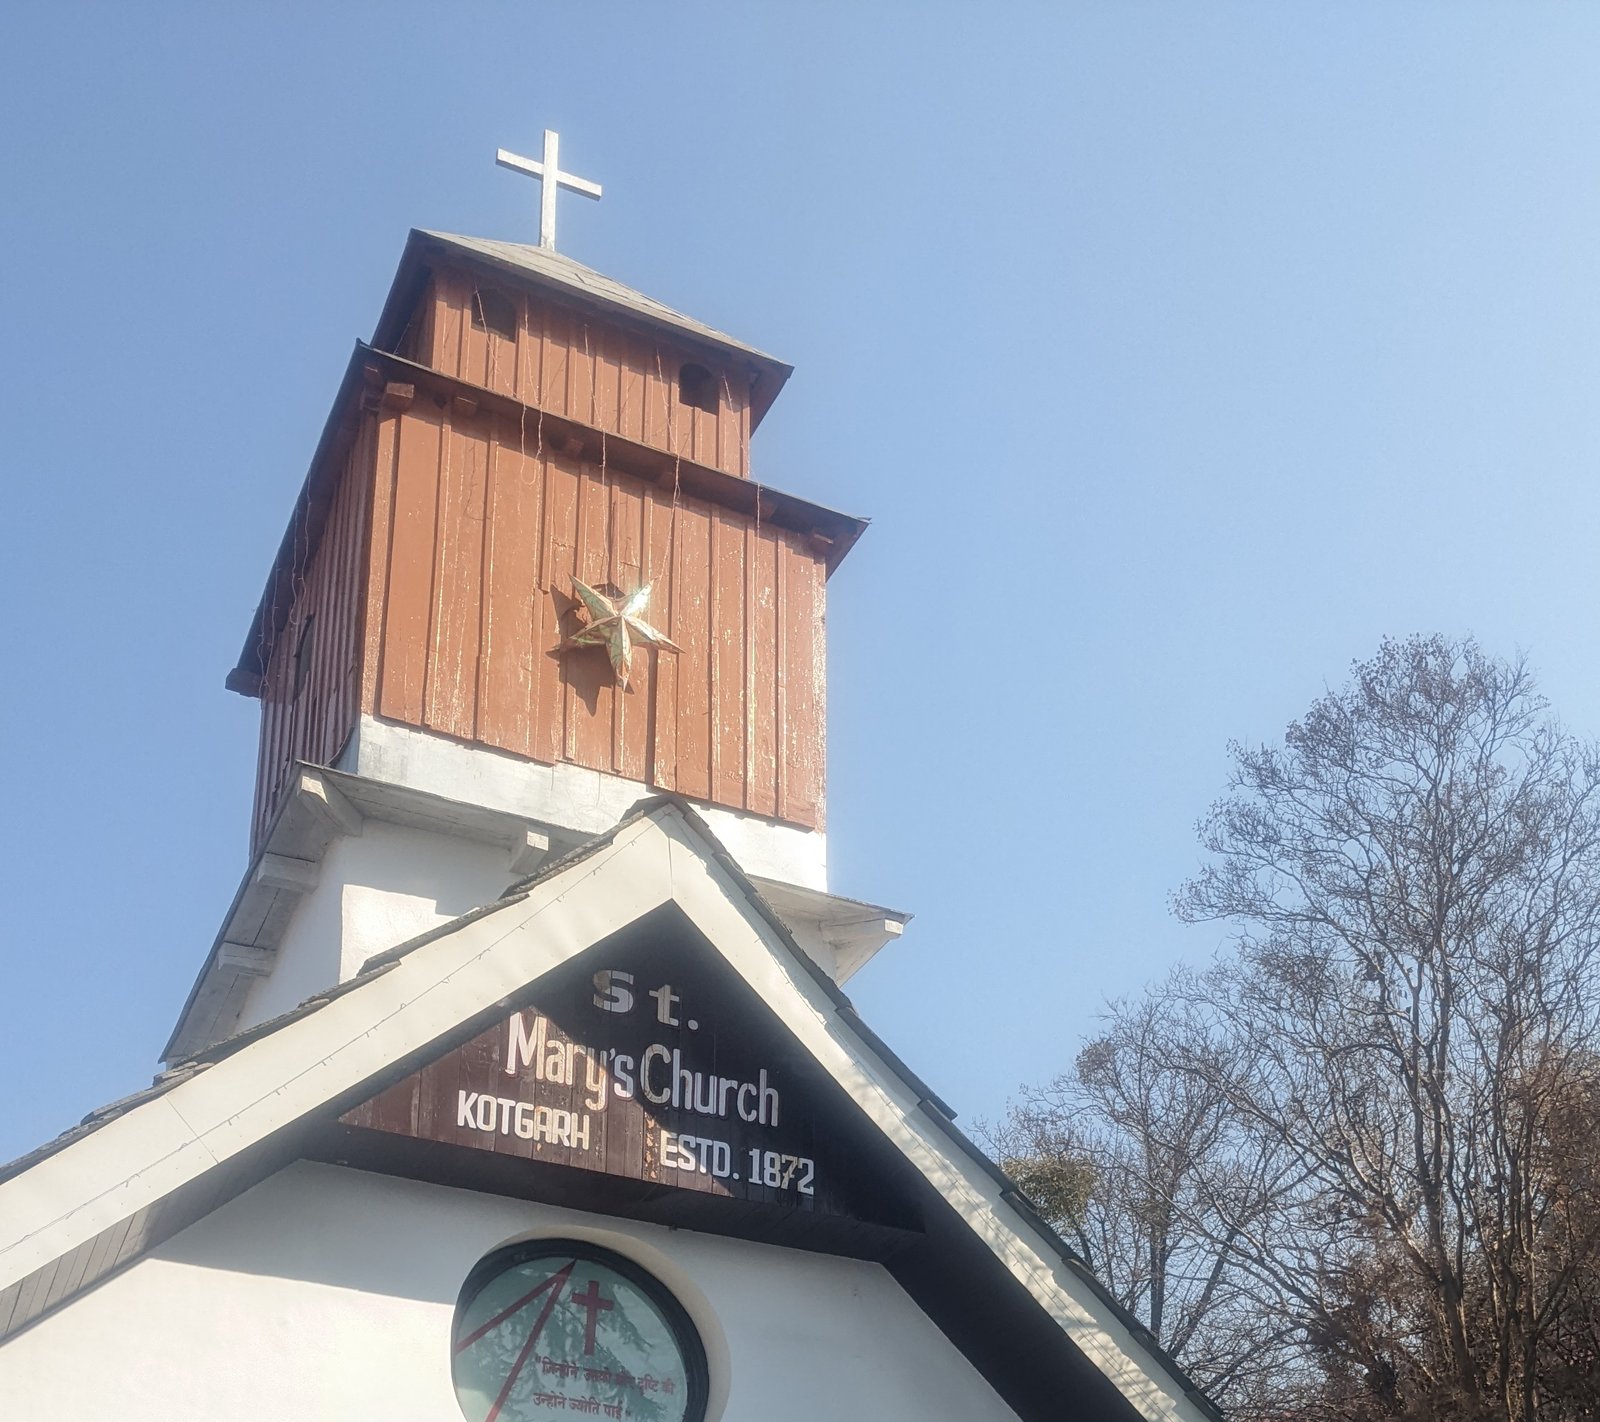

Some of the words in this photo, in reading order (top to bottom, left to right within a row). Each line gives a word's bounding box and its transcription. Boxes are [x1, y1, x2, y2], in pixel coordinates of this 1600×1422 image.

[592, 970, 699, 1031] St.
[505, 1012, 634, 1111] Mary's
[640, 1043, 779, 1127] Church
[457, 1090, 590, 1150] KOTGARH
[660, 1130, 740, 1180] ESTD.
[748, 1148, 815, 1195] 1872
